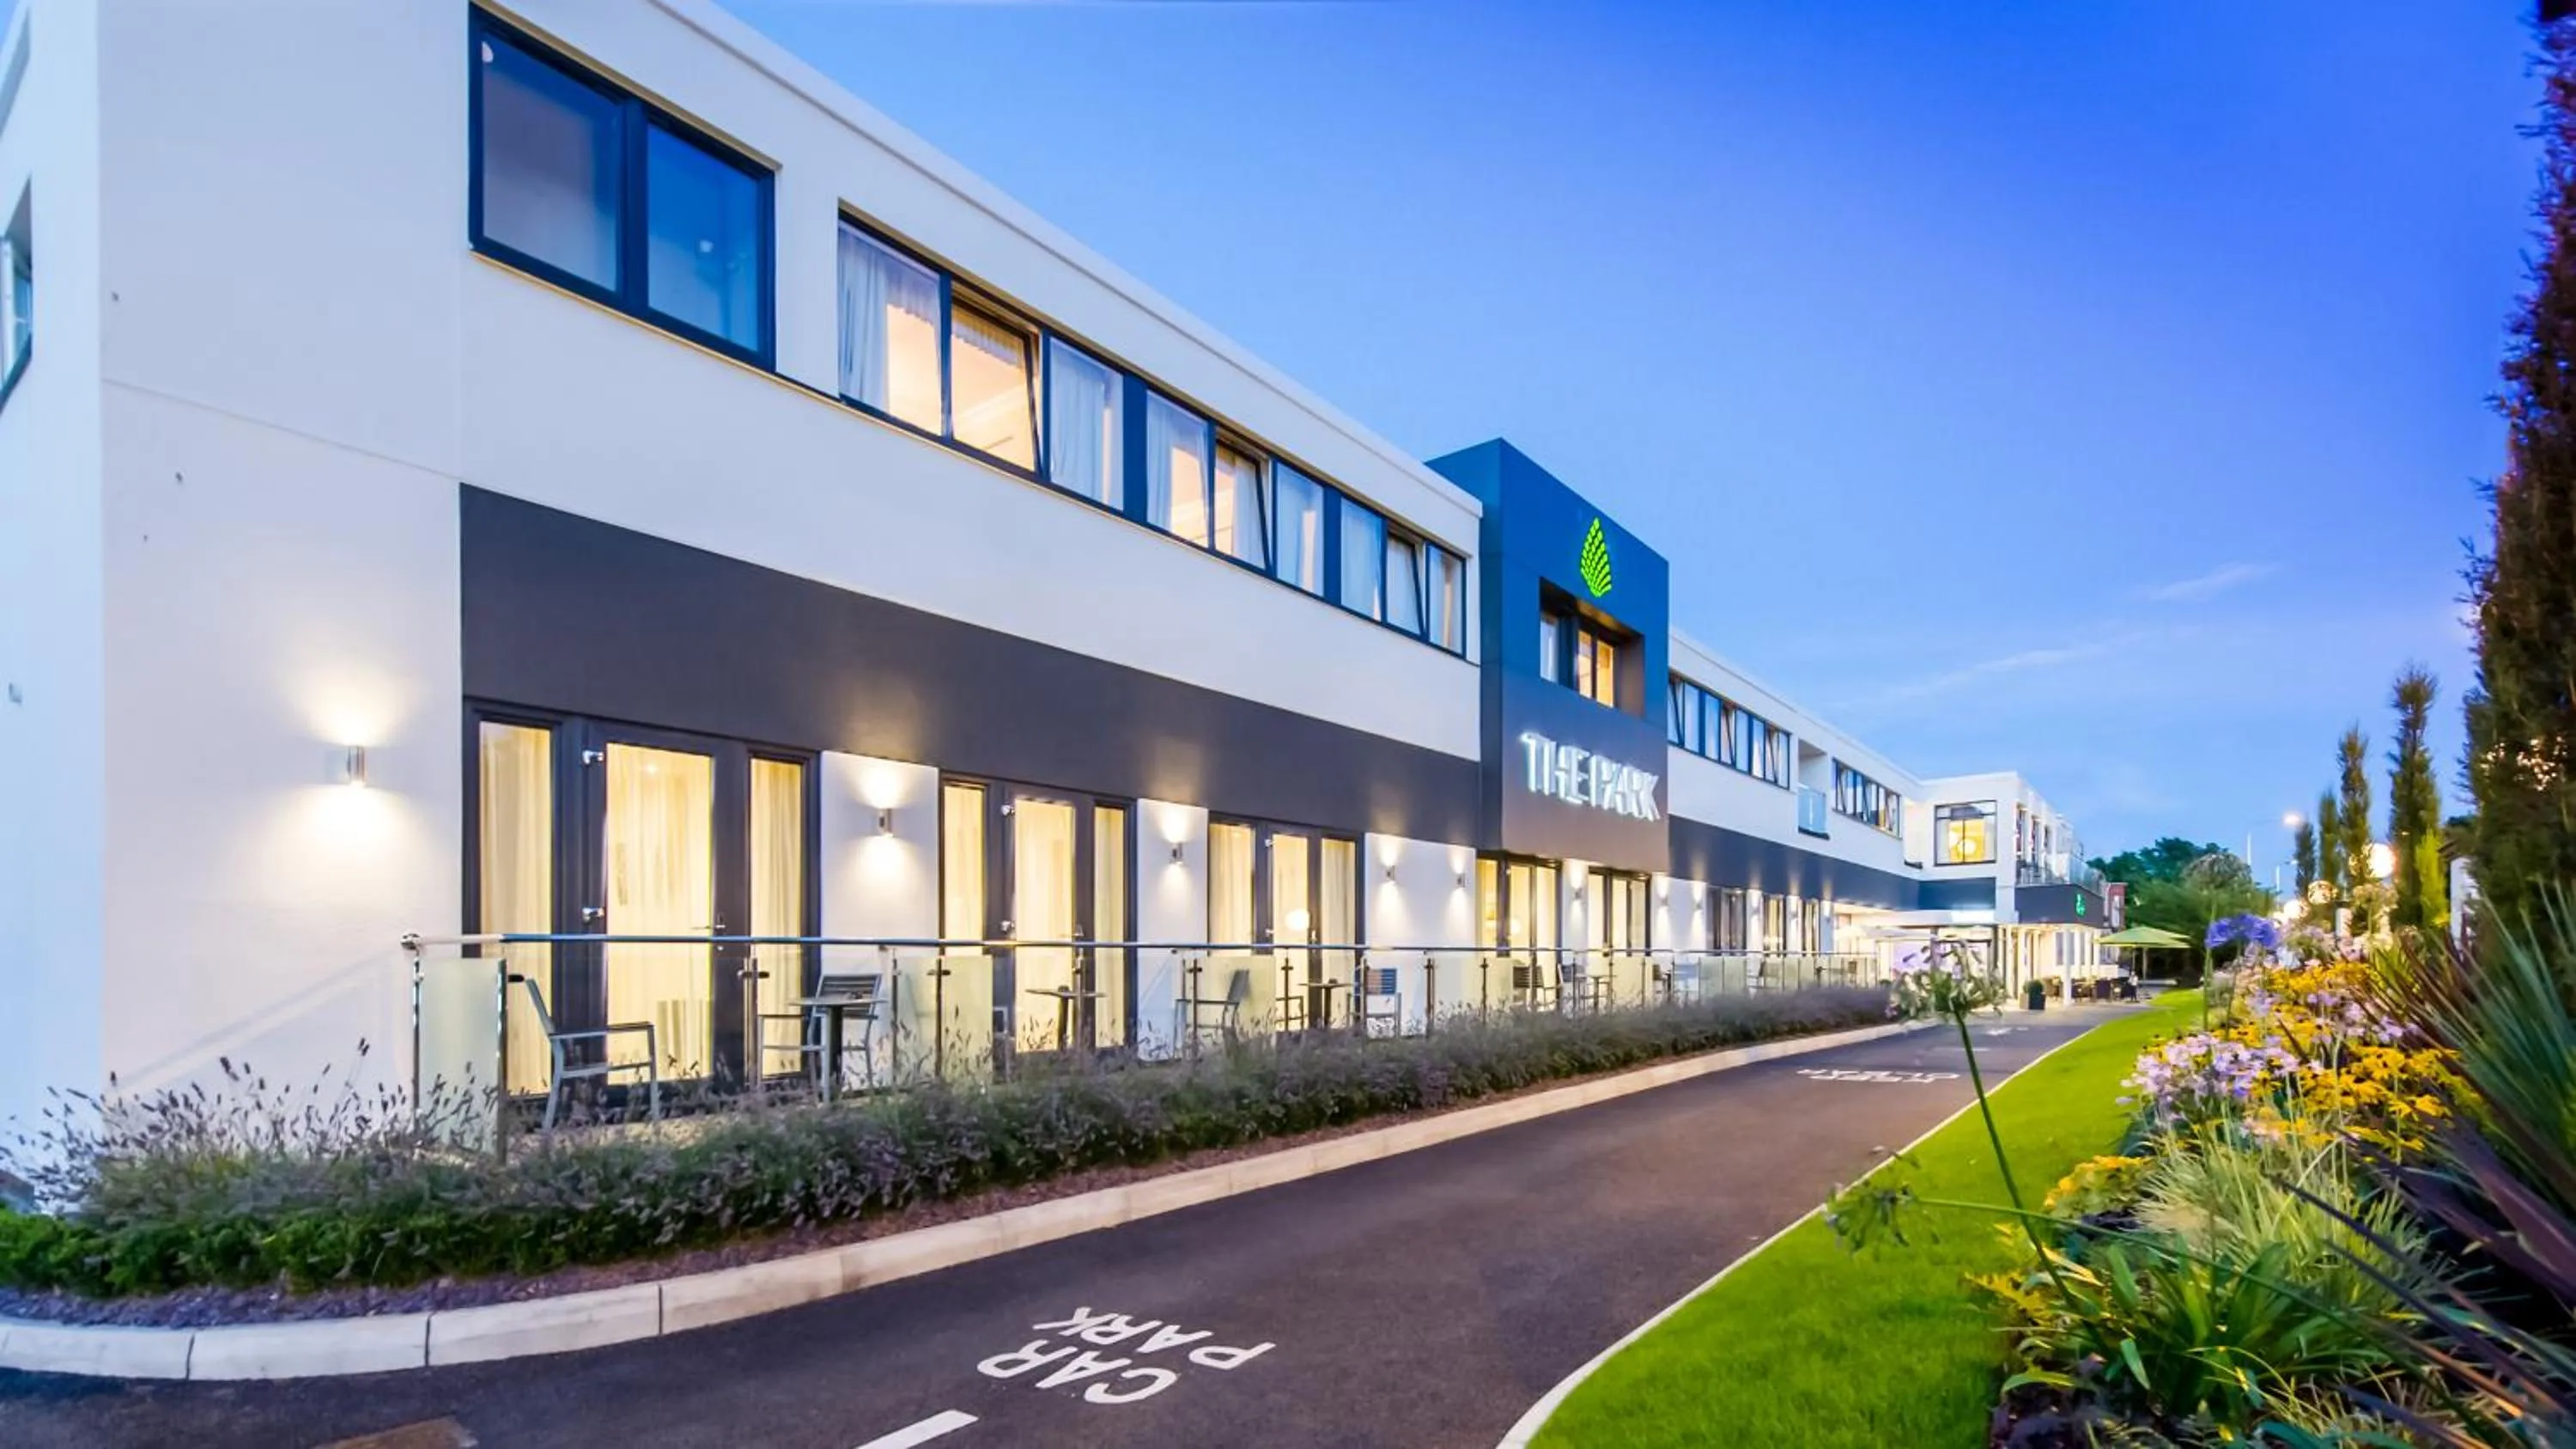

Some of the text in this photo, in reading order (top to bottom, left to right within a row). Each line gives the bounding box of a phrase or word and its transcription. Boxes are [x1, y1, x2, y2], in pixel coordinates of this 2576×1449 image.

[1519, 731, 1661, 822] THE PARK
[977, 1338, 1177, 1404] CAR
[1032, 1307, 1276, 1370] PARK
